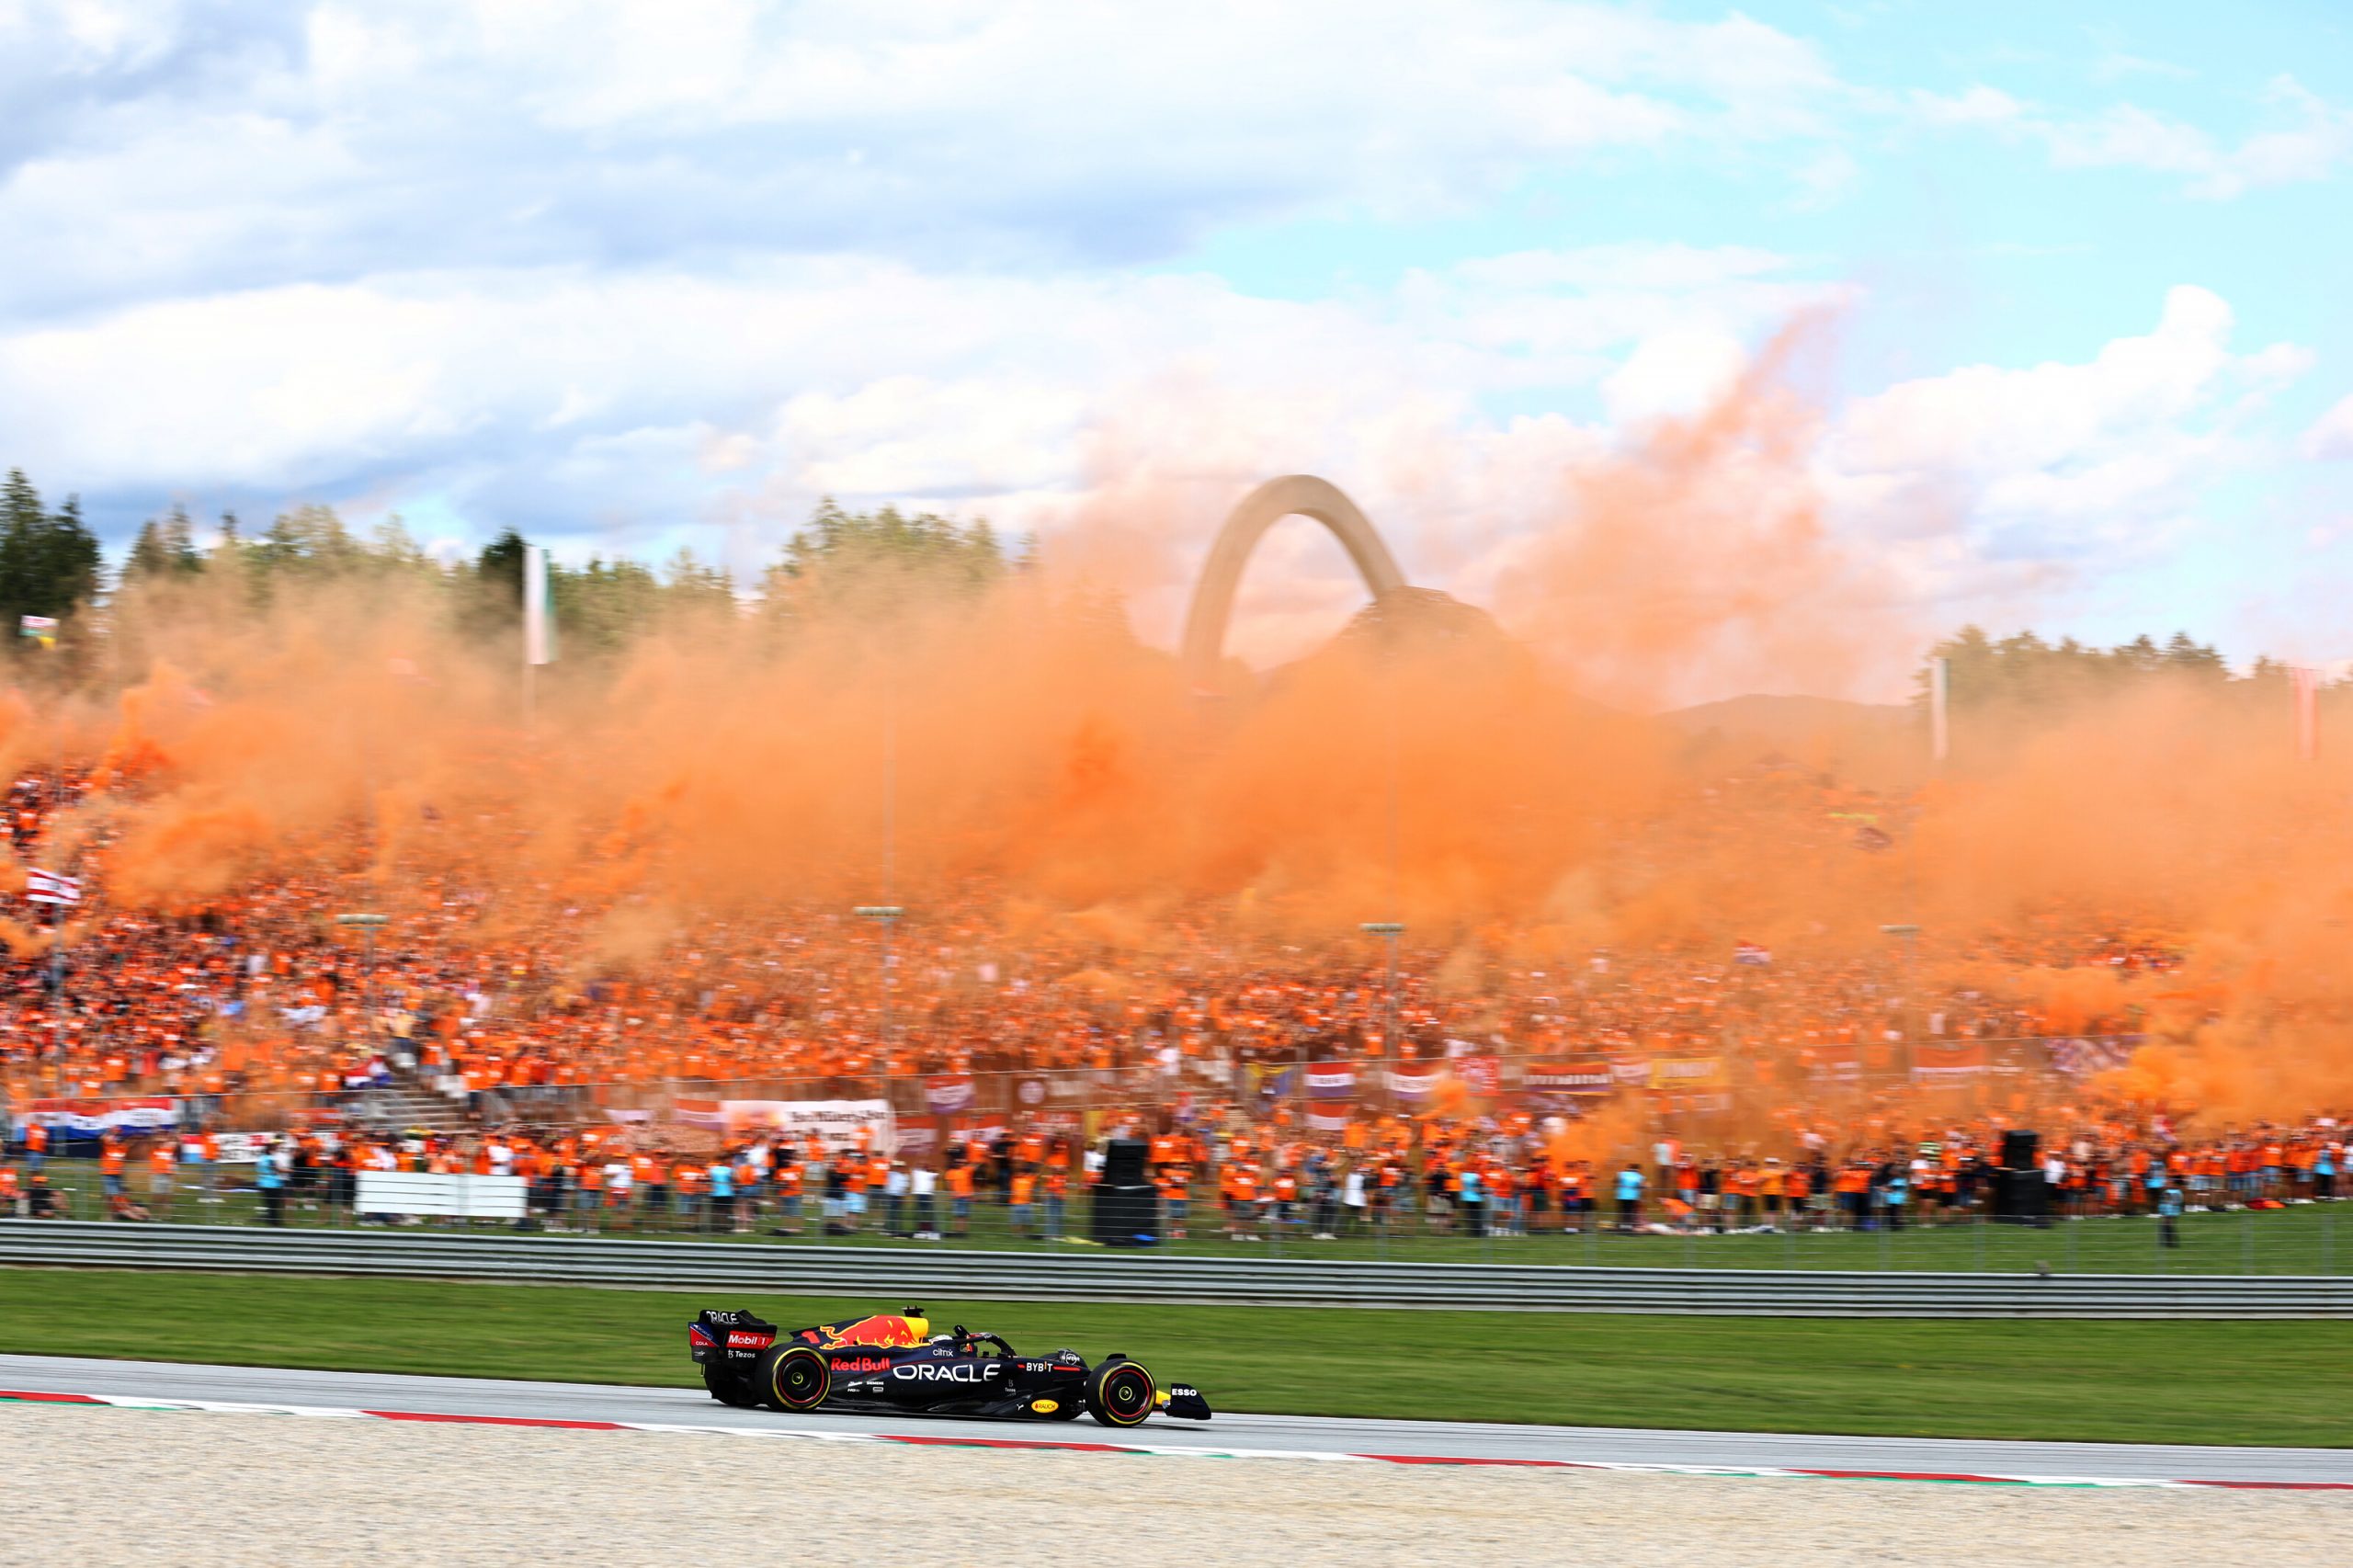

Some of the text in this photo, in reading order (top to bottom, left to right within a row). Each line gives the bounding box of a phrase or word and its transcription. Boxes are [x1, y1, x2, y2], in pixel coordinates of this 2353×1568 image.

[728, 1335, 757, 1345] Mobil
[831, 1357, 890, 1371] Red Bull
[1026, 1361, 1053, 1372] BYBIT
[892, 1364, 1001, 1382] ORACLE
[1171, 1388, 1198, 1396] ESSO
